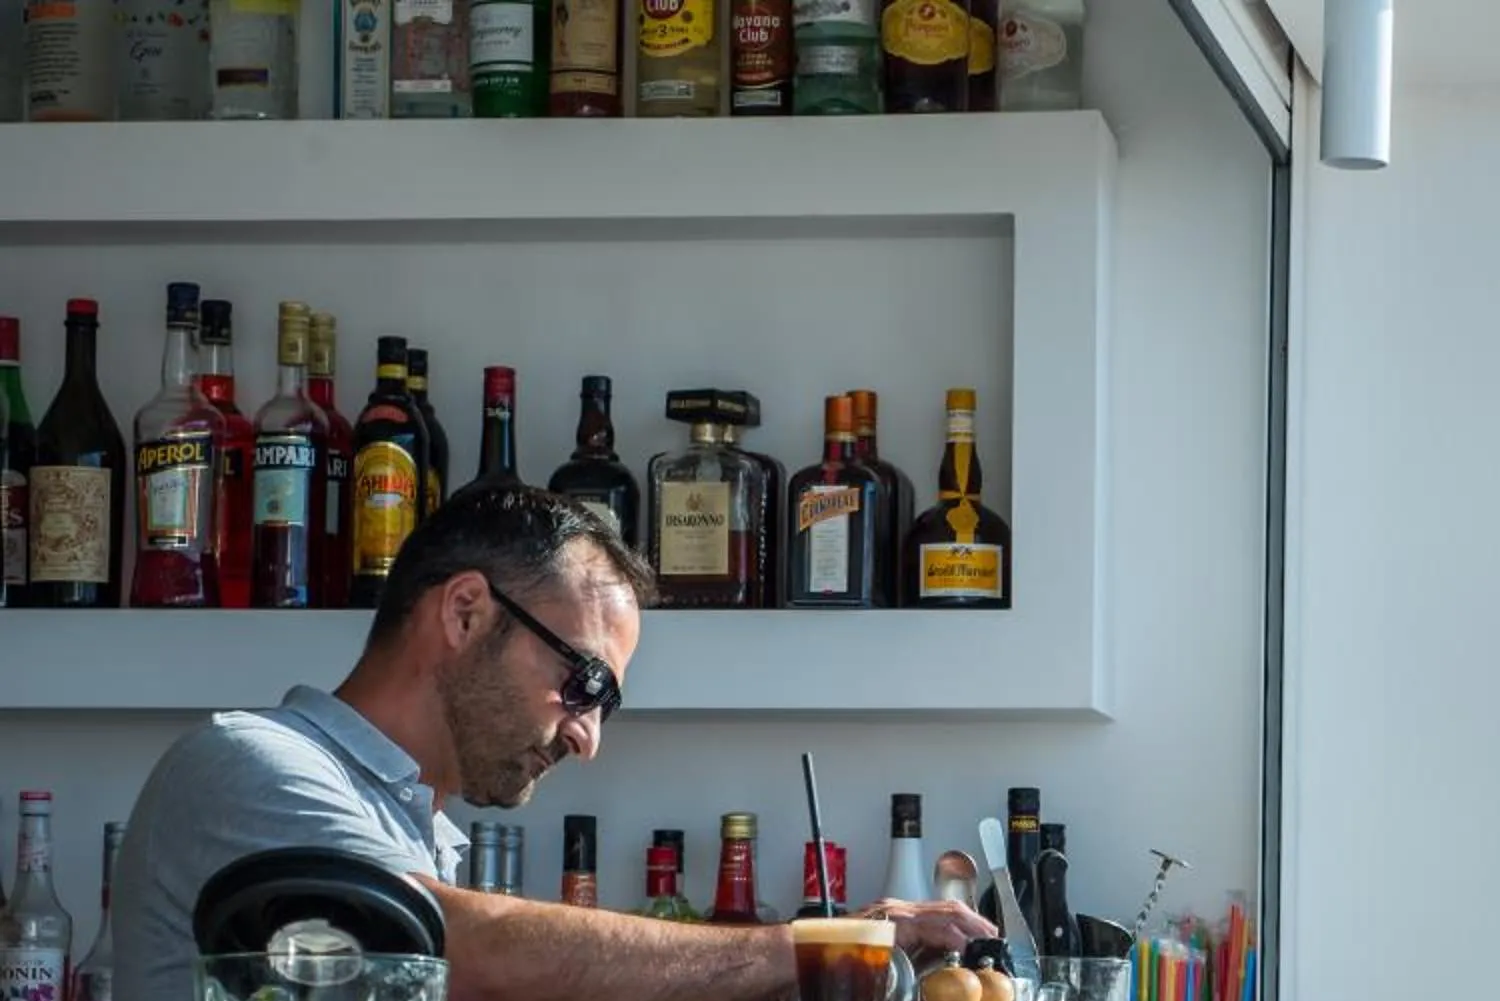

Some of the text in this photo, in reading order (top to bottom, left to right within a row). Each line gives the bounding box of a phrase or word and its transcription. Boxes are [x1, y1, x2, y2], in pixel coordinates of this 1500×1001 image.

[138, 442, 205, 470] APEROL
[255, 446, 316, 466] AMPARI
[665, 513, 724, 527] DISARONNO
[1, 967, 53, 980] ONIN
